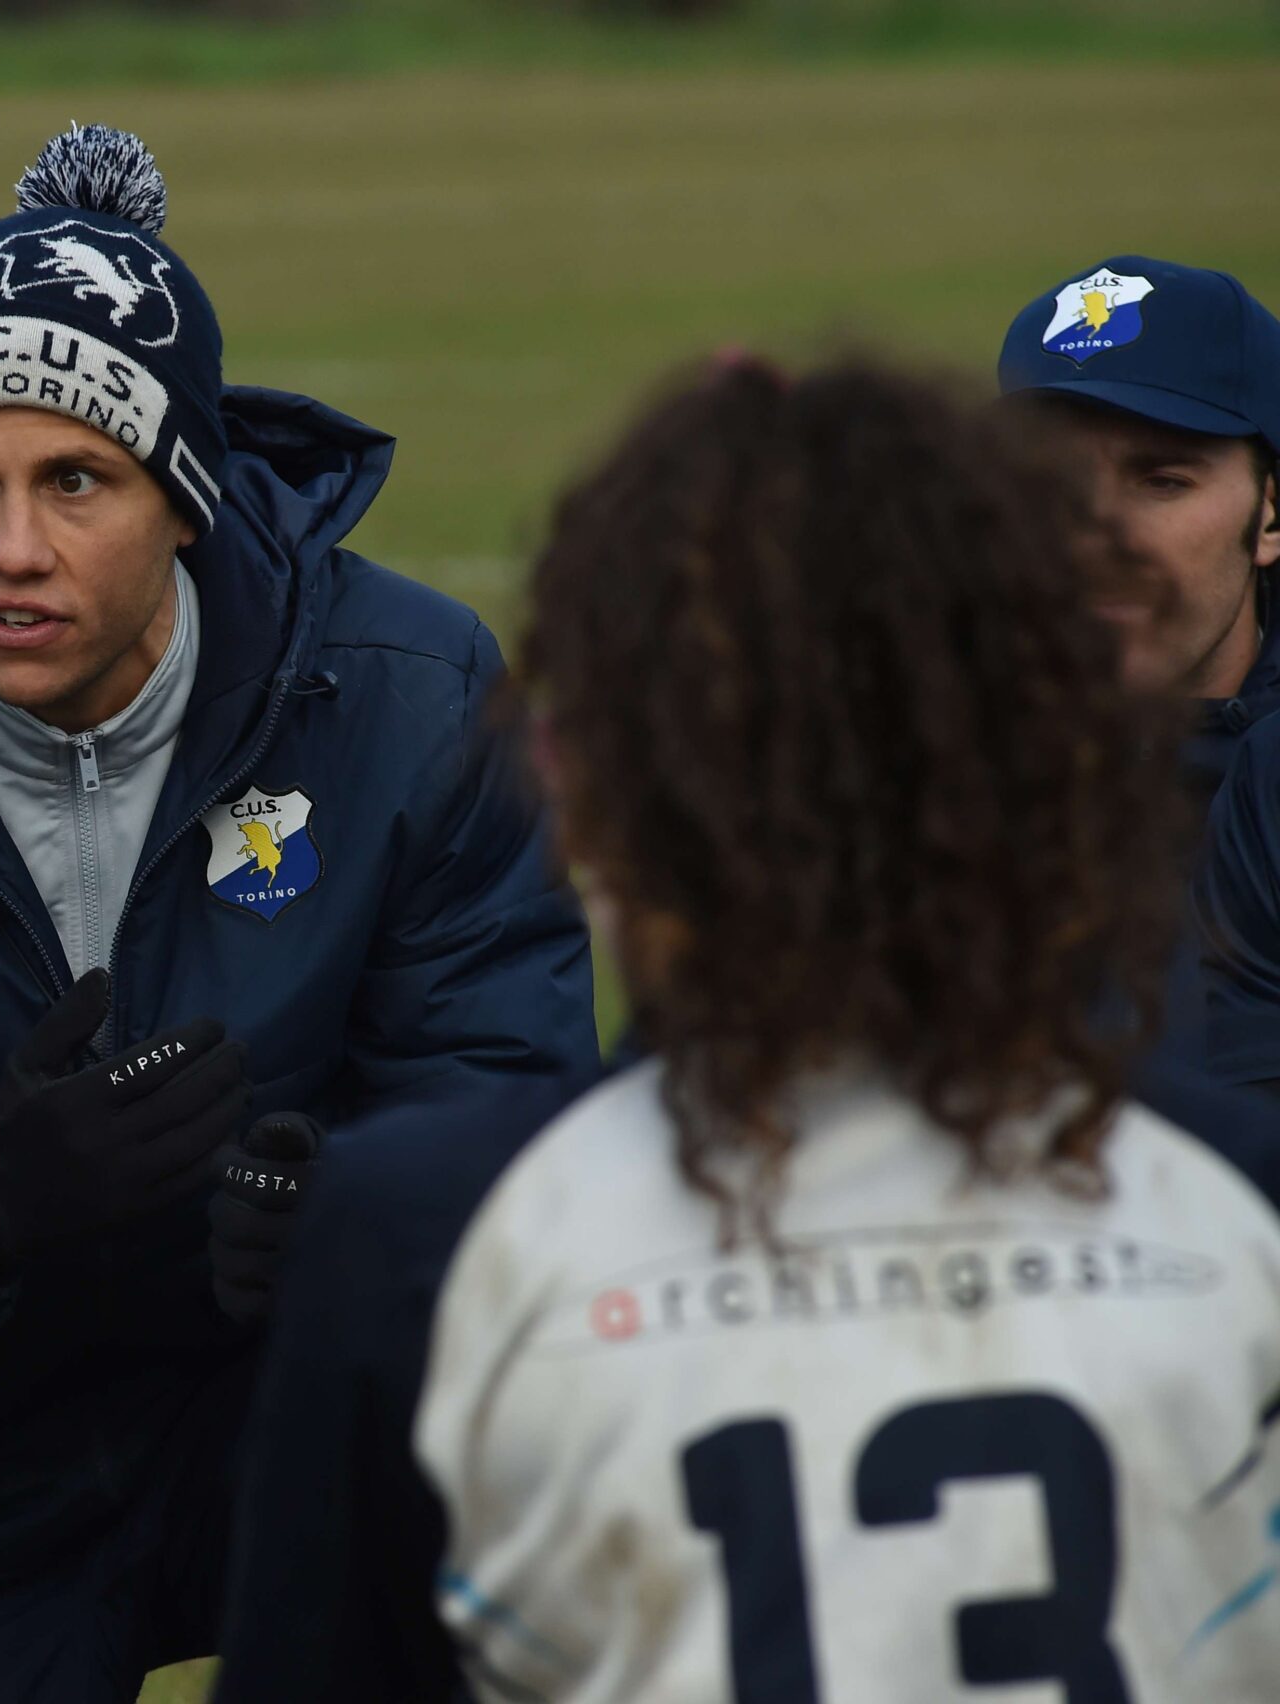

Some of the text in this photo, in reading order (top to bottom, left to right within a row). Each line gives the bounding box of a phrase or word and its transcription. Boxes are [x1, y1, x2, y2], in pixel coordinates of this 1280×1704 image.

[1060, 340, 1113, 351] TORINO
[230, 799, 282, 818] C.U.S.
[236, 887, 297, 903] TORINO
[109, 1041, 186, 1085] KIPSTA
[226, 1164, 297, 1191] KIPSTA
[677, 1389, 1135, 1704] 13
